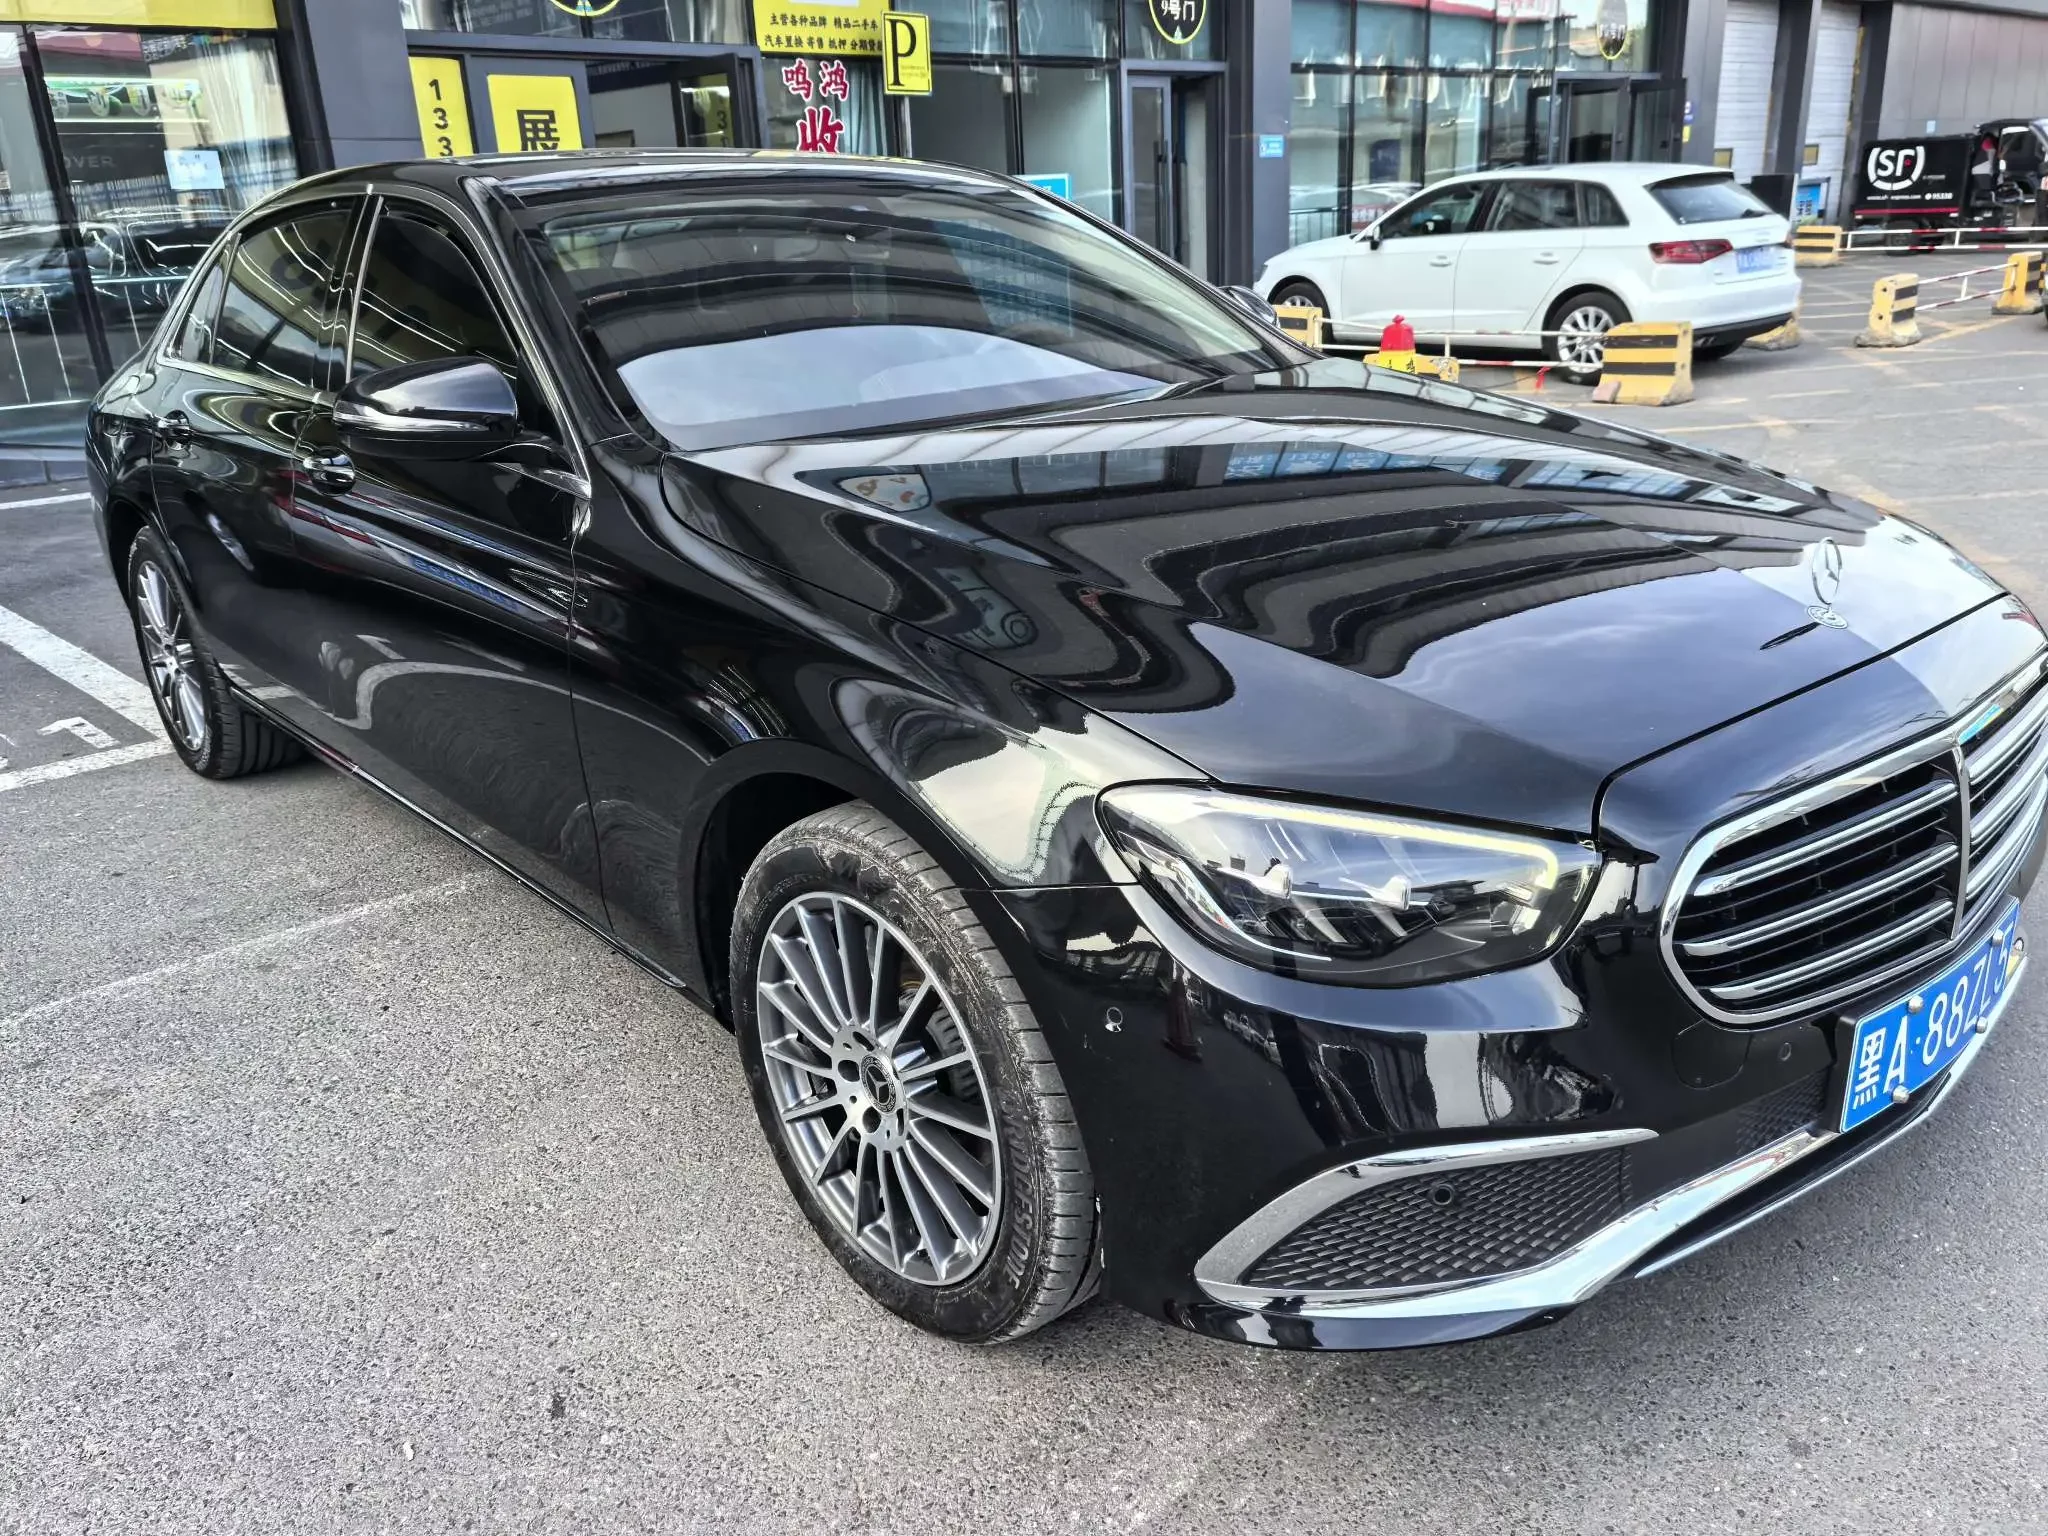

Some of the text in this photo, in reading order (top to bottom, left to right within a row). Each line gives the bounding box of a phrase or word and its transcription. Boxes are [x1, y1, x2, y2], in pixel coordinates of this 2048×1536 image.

[886, 18, 917, 86] P
[516, 109, 560, 151] 展
[796, 106, 845, 153] 收
